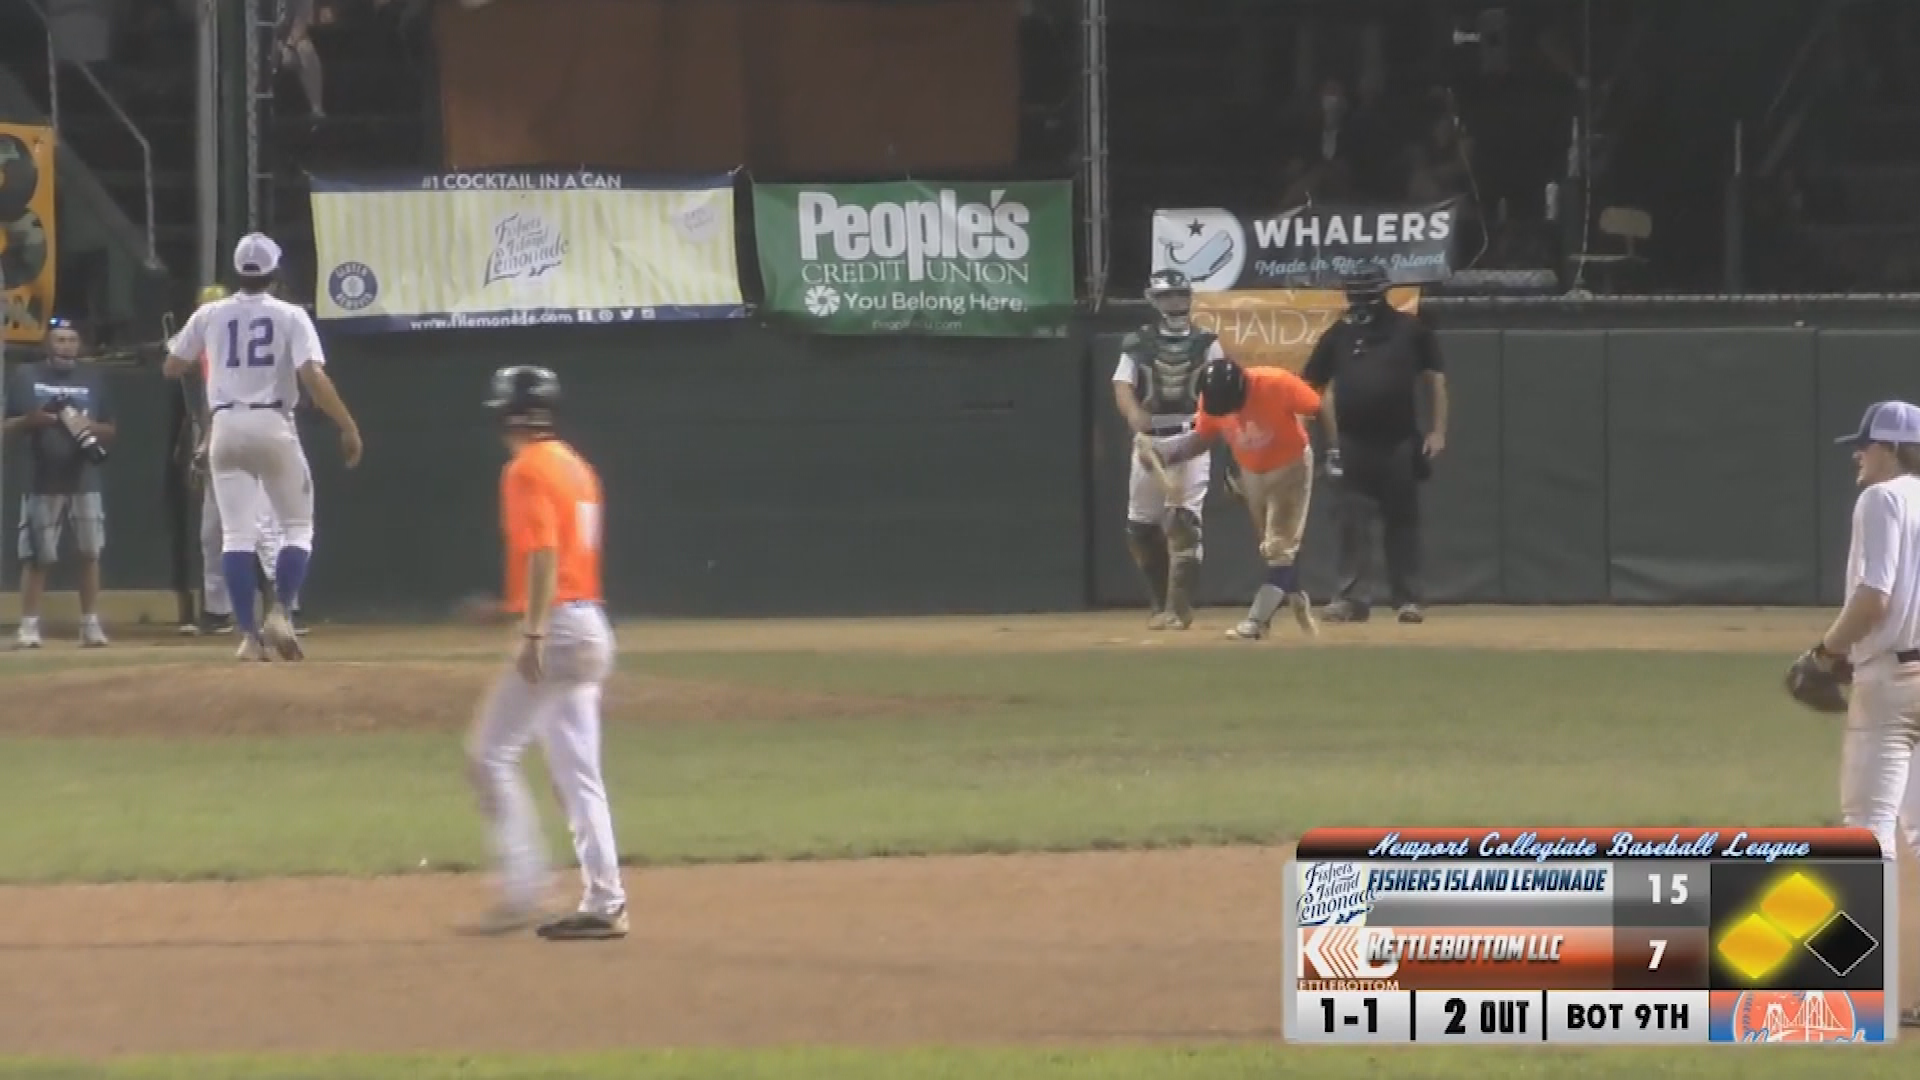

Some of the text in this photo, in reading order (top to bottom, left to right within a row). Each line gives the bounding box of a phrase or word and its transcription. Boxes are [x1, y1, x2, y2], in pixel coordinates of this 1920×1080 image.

[443, 174, 535, 190] COCKTAIL
[539, 174, 559, 189] IN
[563, 174, 578, 189] A
[581, 173, 621, 190] CAN
[798, 188, 1031, 282] People's
[1254, 210, 1451, 249] WHALERS
[801, 261, 1029, 285] CREDIT UNION
[1254, 257, 1307, 277] Made
[844, 292, 887, 311] You
[892, 291, 966, 315] Belong
[226, 317, 274, 368] 12
